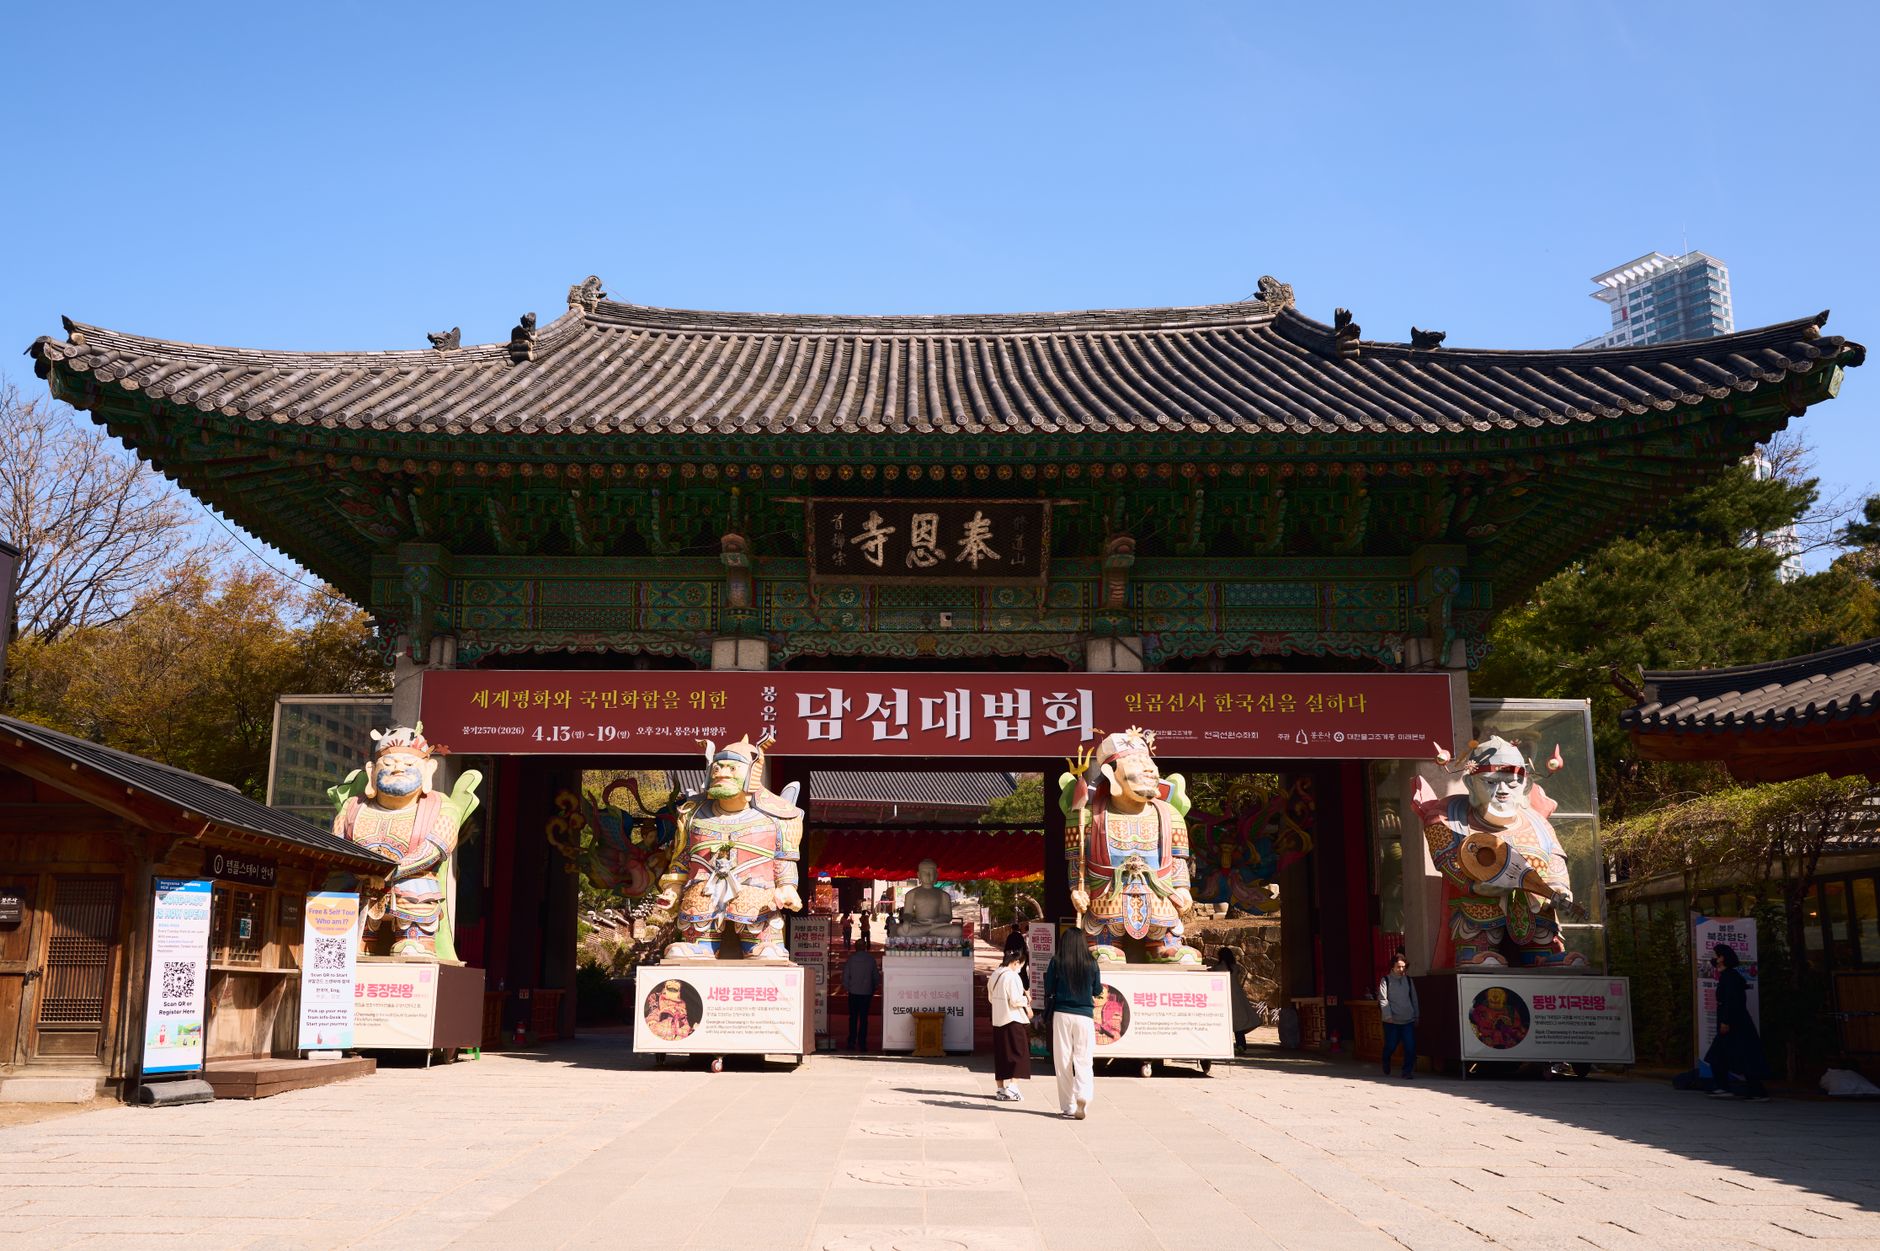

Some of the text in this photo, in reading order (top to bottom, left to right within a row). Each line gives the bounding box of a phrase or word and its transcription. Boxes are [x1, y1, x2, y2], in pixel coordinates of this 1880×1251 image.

[470, 689, 728, 710] 세계평화와 국민화합을 위한
[1124, 693, 1367, 714] 일곱선사 한국선을 설하다
[759, 686, 777, 740] 봉은사
[795, 687, 1094, 742] 담선대법회
[462, 726, 525, 736] 불기2570(2026)
[636, 726, 654, 736] 오후
[655, 726, 672, 737] 2시,
[674, 726, 700, 736] 봉은사
[702, 727, 728, 737] 법왕루
[226, 860, 274, 881] 템플스테이 안내
[794, 932, 808, 940] 사전
[366, 983, 414, 998] 증장천왕
[707, 986, 779, 1002] 서방 광목천왕
[1133, 992, 1208, 1008] 북방 다문천왕
[1532, 995, 1607, 1011] 동방 지국천왕
[893, 1006, 919, 1015] 인도에서
[938, 1006, 964, 1016] 부처님
